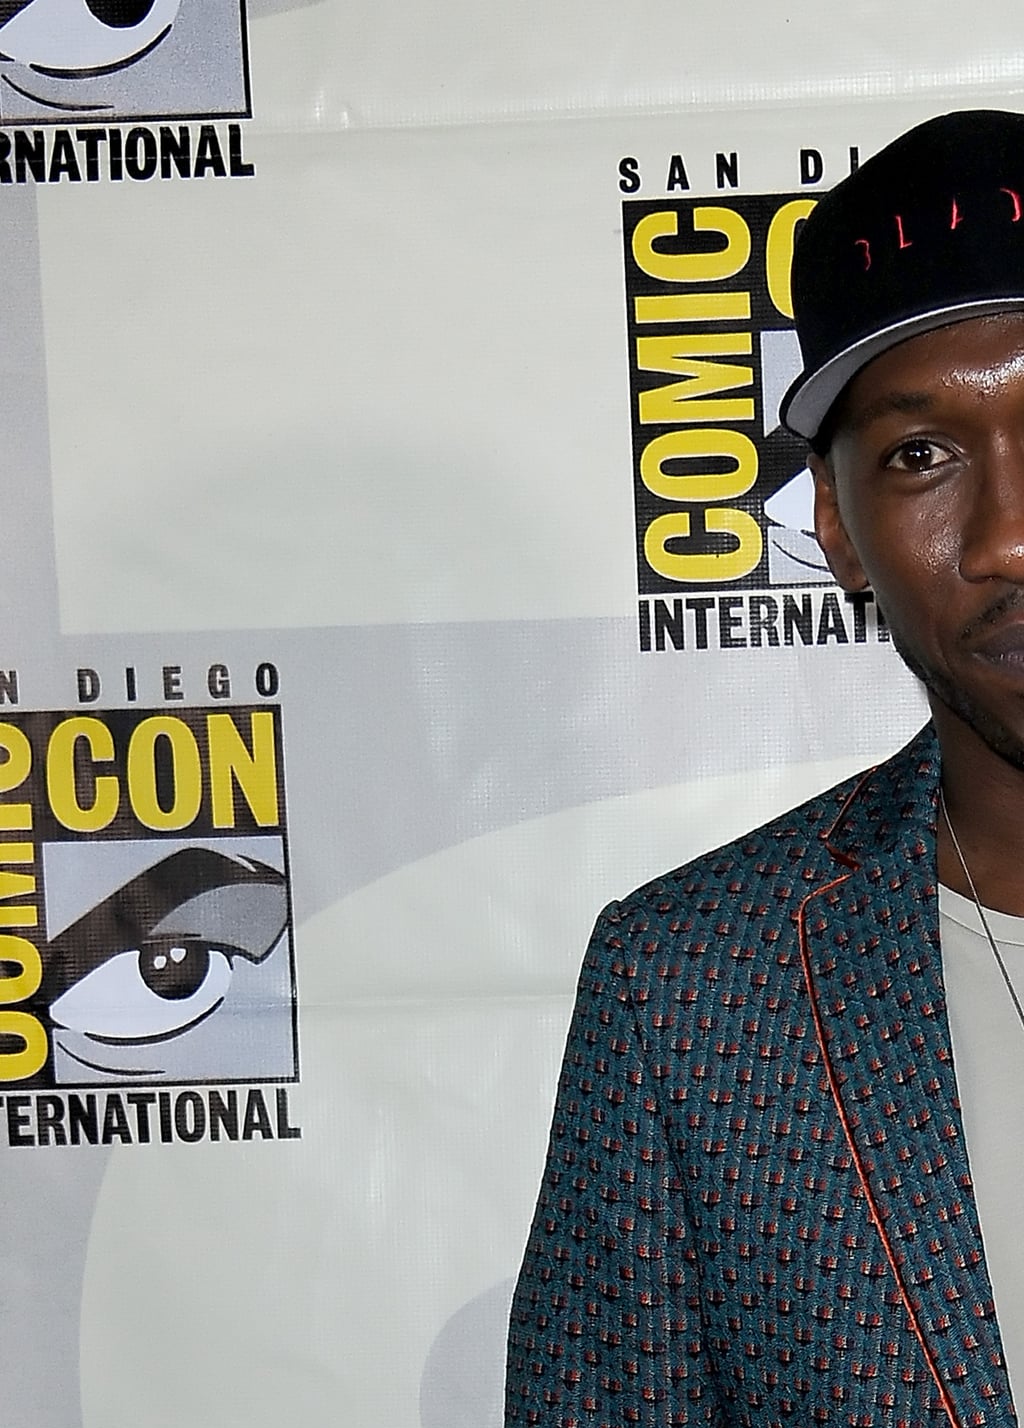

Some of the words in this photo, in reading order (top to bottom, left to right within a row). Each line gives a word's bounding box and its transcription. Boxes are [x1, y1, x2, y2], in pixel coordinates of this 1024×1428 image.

[618, 152, 739, 194] SAN
[631, 206, 763, 583] COMIC
[77, 662, 280, 703] DIEGO
[47, 712, 280, 832] CON
[0, 1089, 302, 1147] ERNATIONAL
